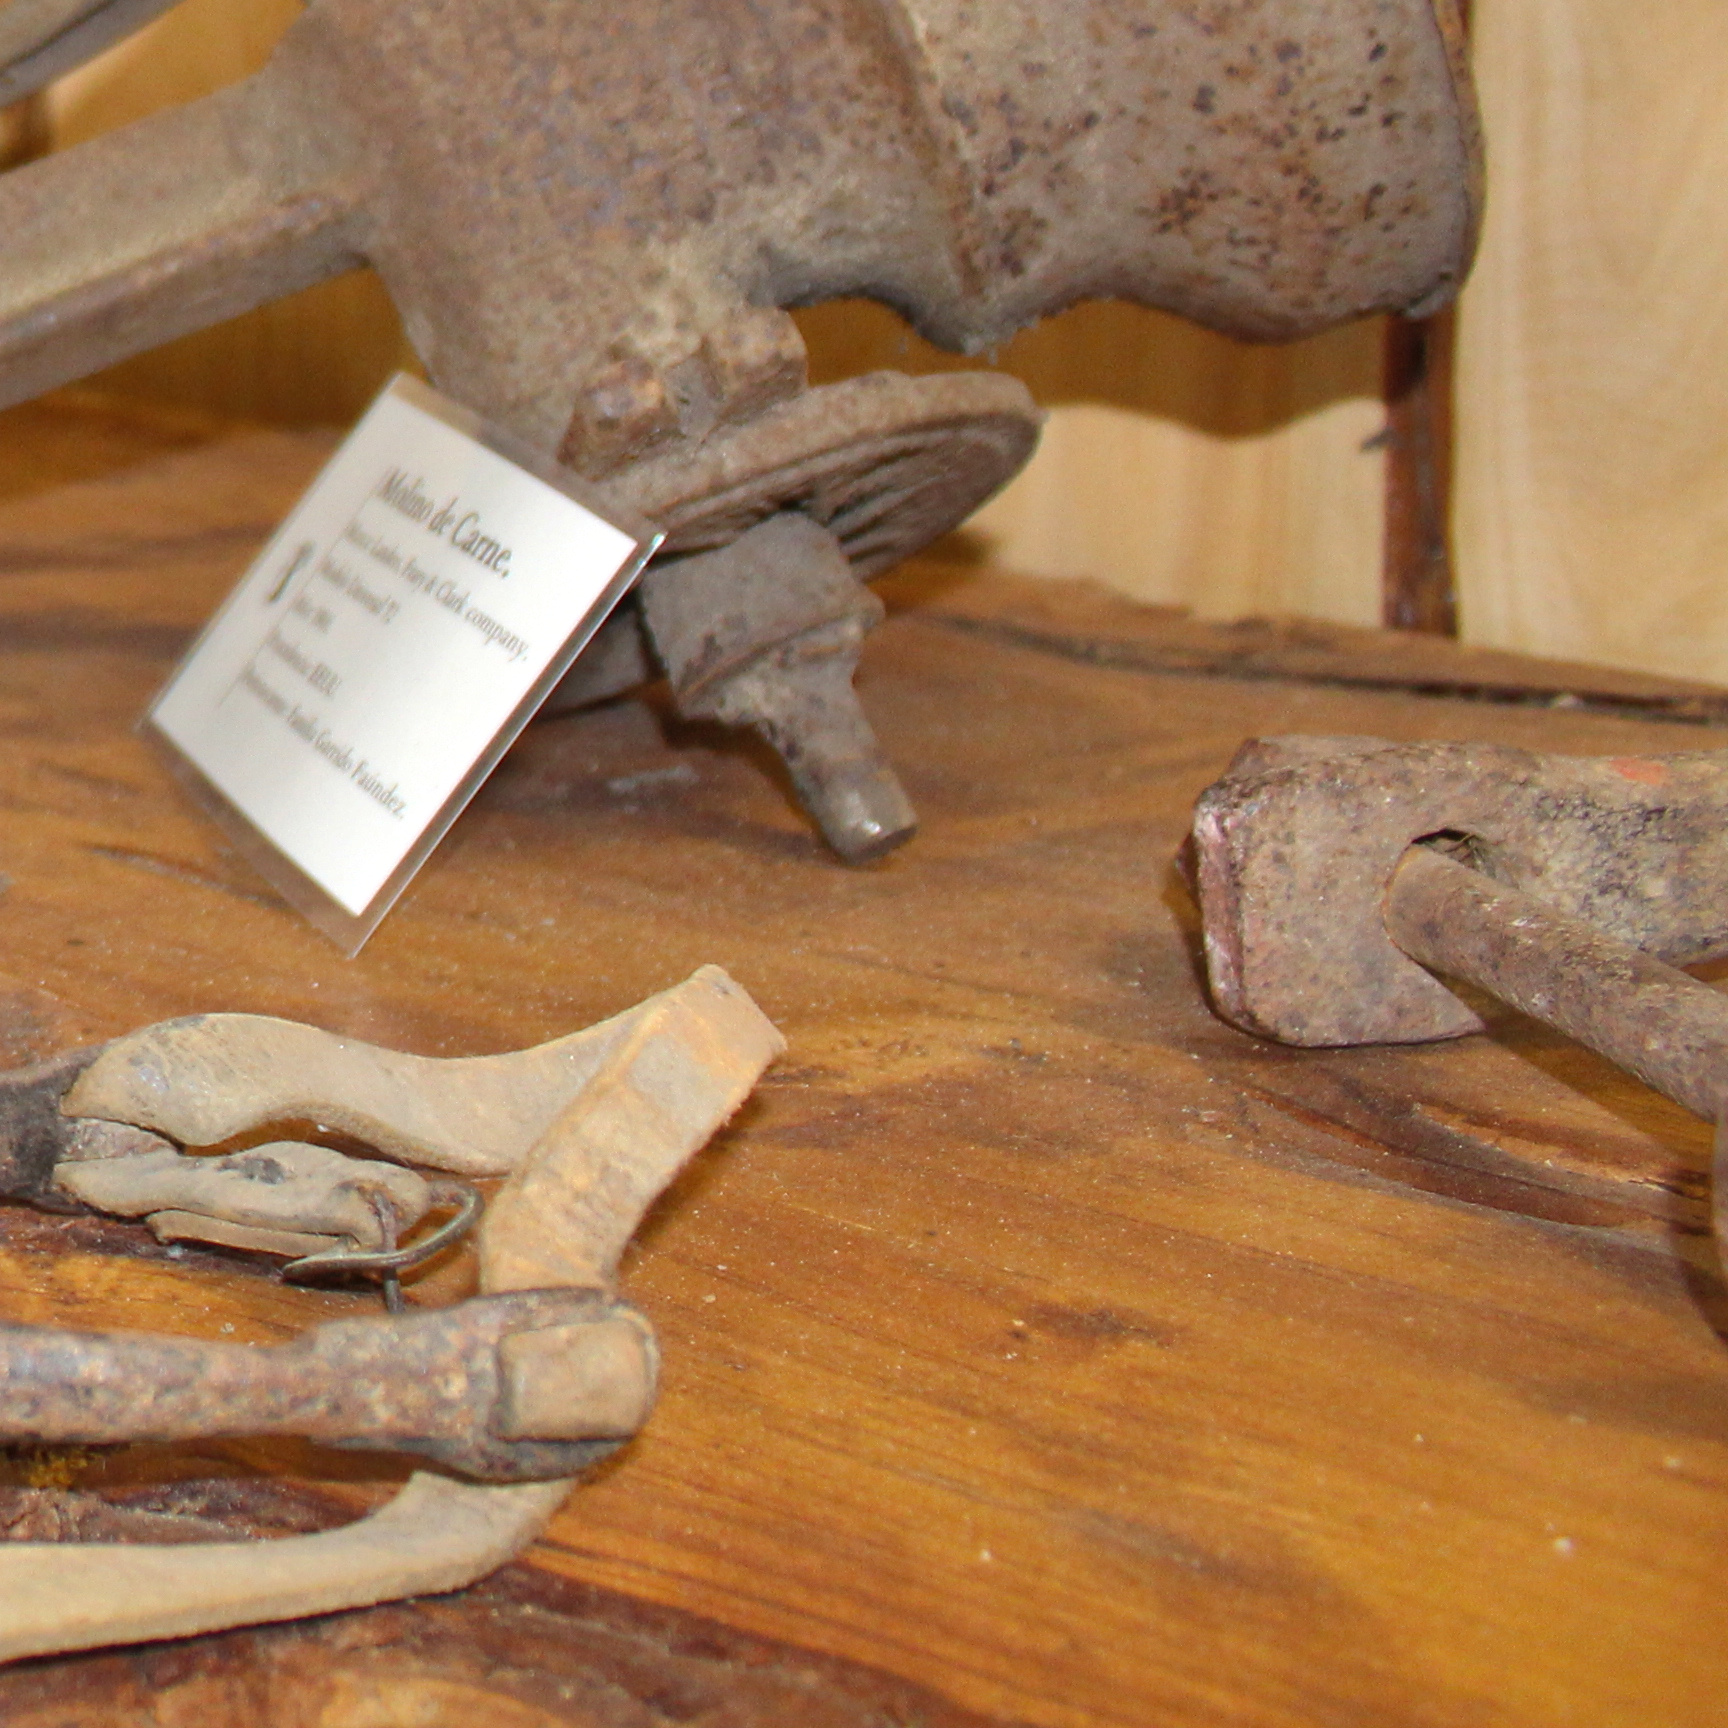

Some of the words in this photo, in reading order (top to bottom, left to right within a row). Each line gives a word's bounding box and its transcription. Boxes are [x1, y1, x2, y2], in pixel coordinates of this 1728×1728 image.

[378, 468, 435, 523] Molino
[427, 496, 458, 536] de
[449, 510, 512, 579] Carne.
[463, 607, 530, 663] company.
